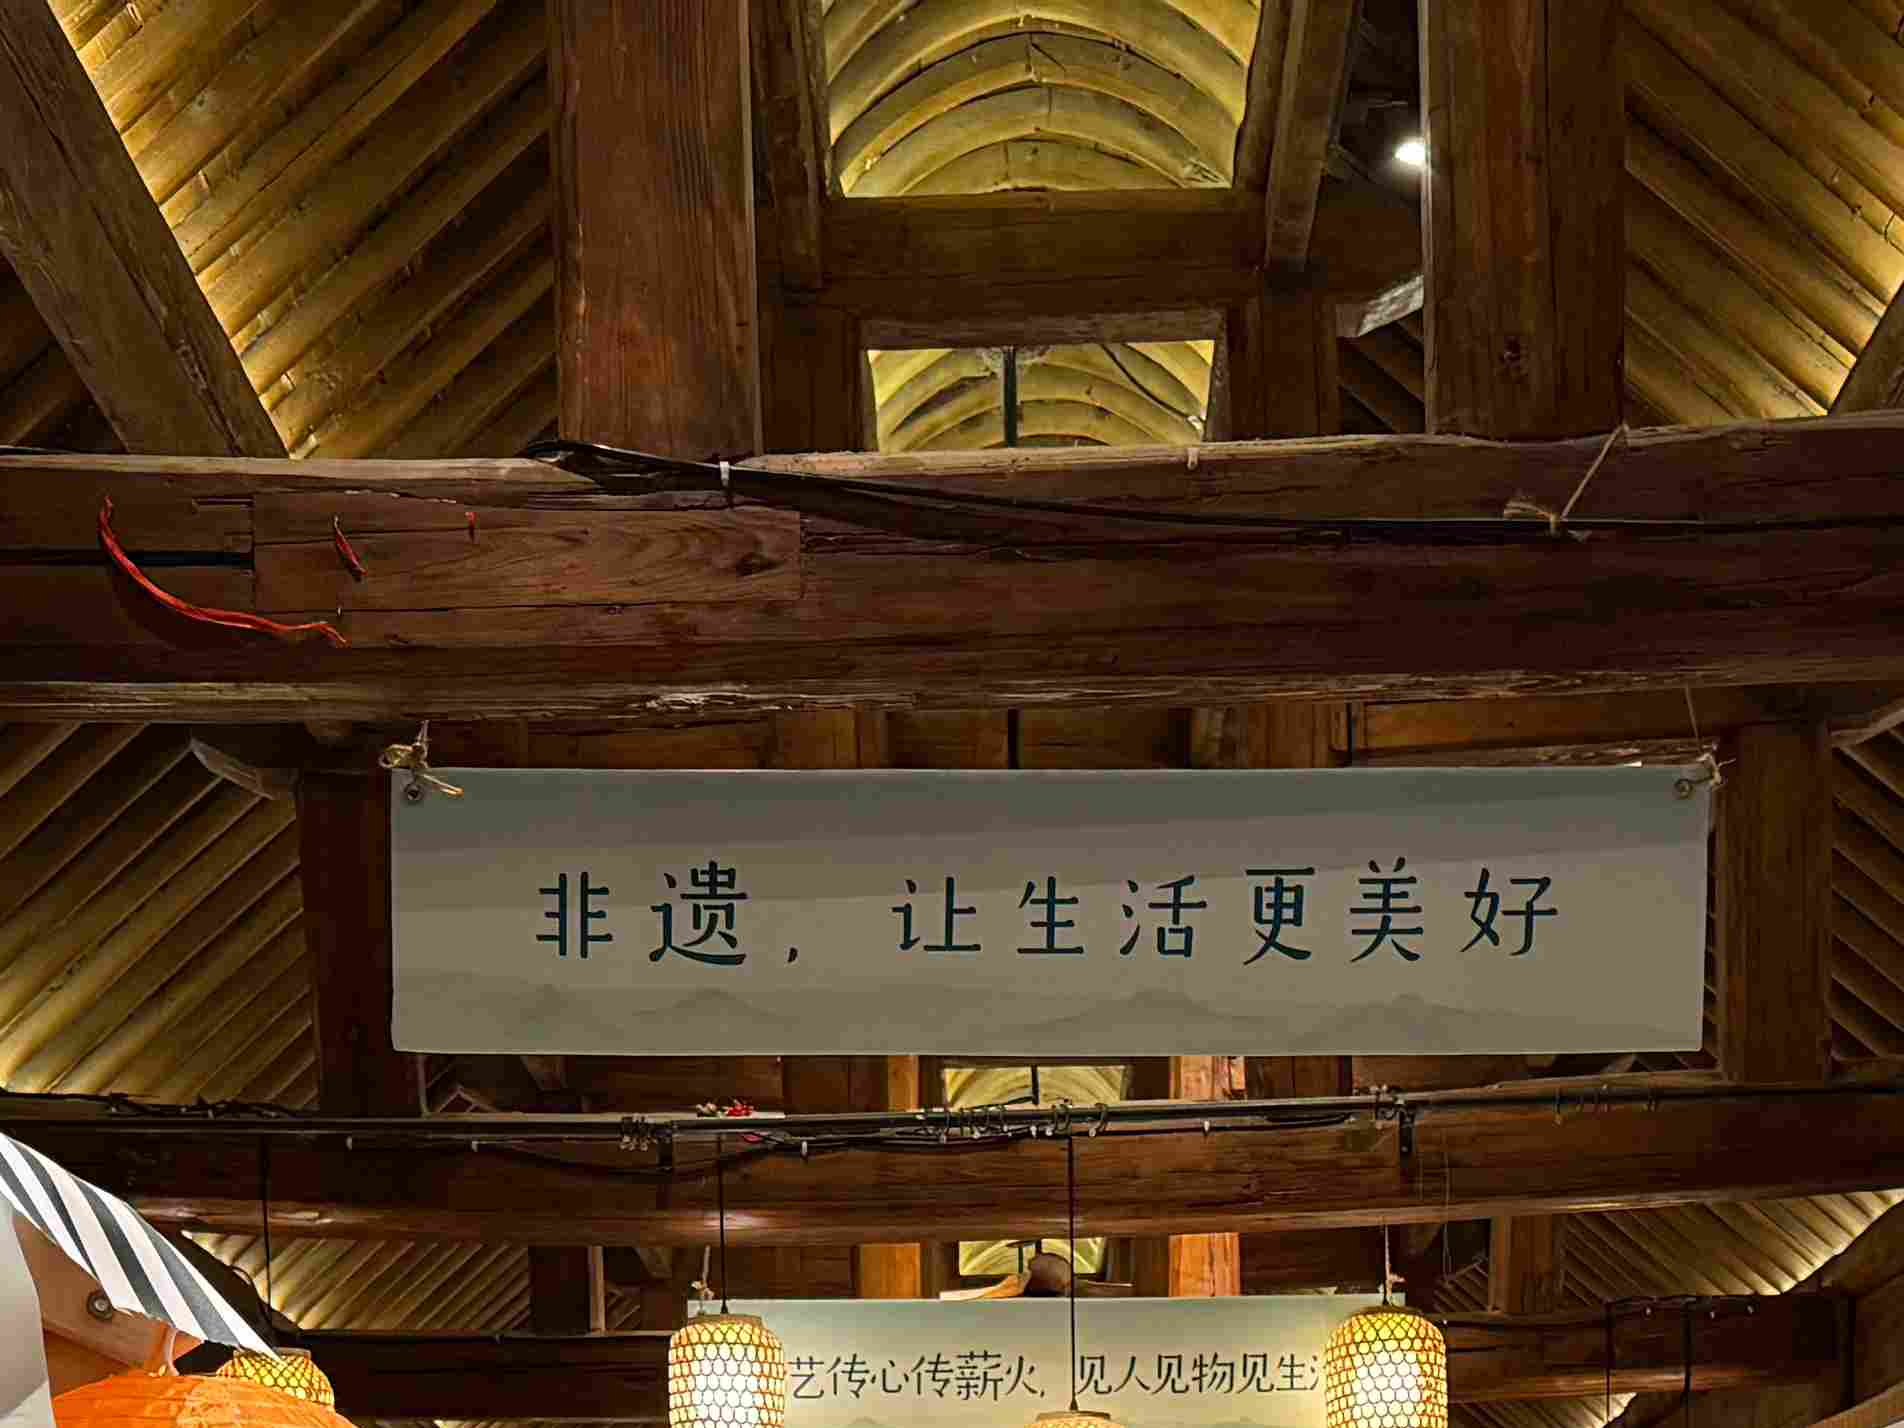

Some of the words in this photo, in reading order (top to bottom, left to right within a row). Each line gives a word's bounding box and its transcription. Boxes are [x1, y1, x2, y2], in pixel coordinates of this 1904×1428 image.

[536, 856, 1559, 968] 非遗，让生活更美好
[787, 1350, 1325, 1401] 艺传心传薪火，见人见物见生
